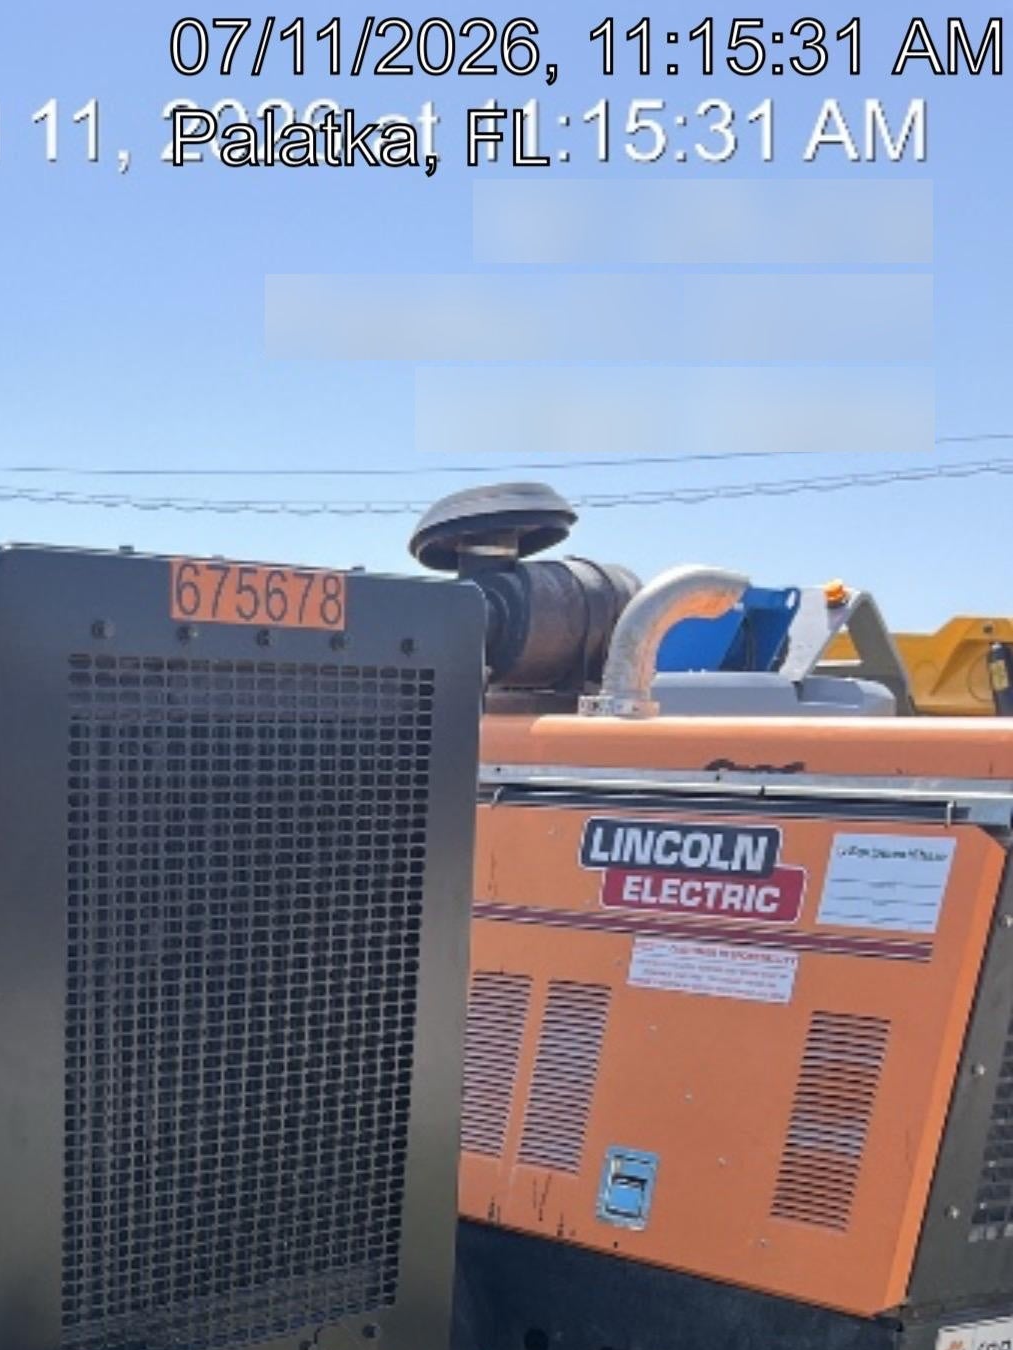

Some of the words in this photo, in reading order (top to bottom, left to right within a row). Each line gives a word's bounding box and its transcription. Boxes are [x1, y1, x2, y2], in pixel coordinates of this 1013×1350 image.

[175, 563, 342, 625] 675678
[589, 827, 768, 873] LINCOLN
[622, 875, 781, 913] ELECTRIC
